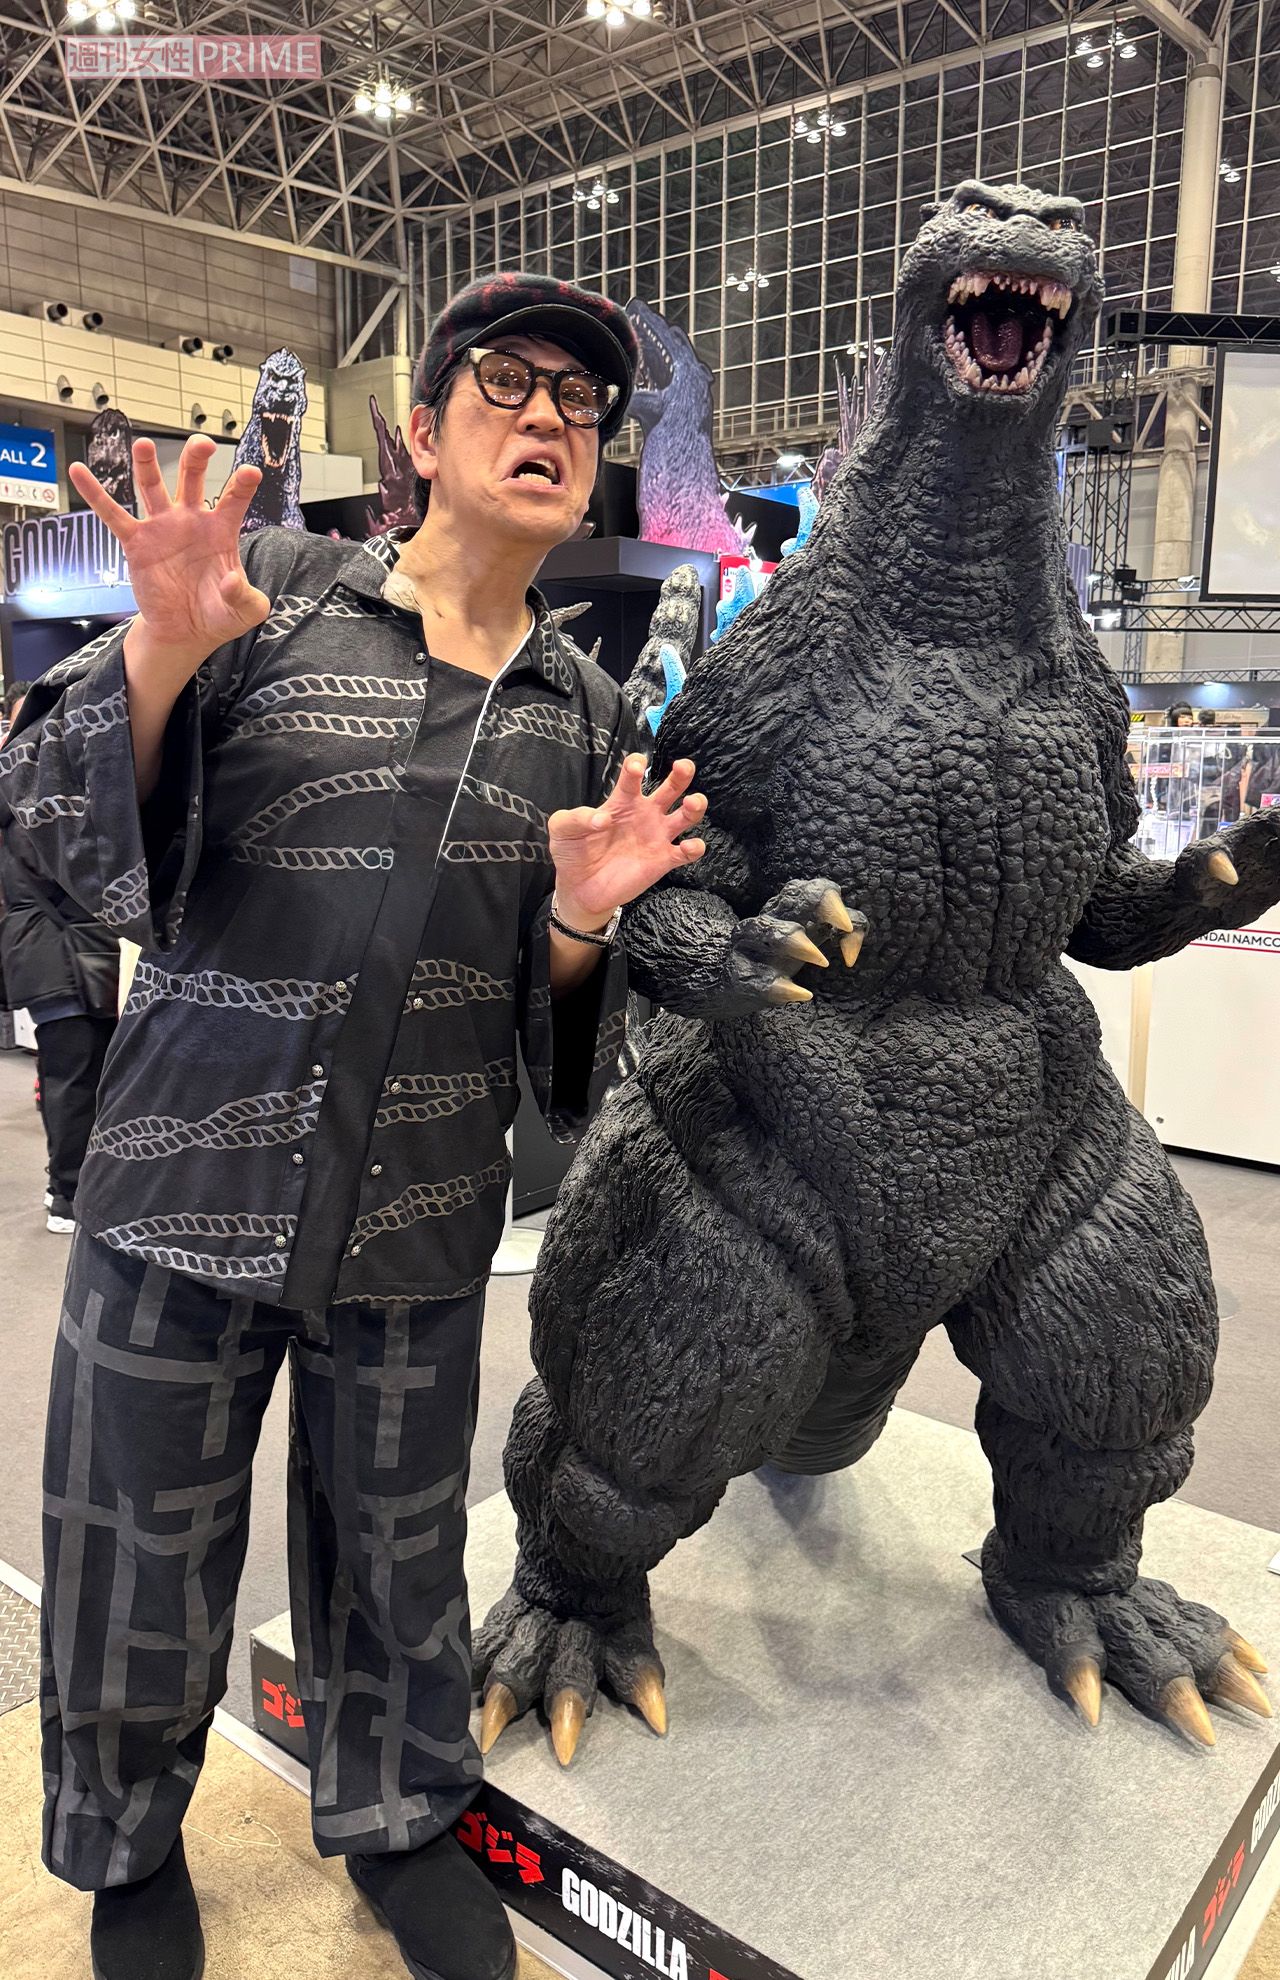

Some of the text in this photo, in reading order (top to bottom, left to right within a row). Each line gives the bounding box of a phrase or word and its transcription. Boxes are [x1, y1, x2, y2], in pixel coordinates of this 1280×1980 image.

[30, 442, 48, 468] 2
[1199, 932, 1280, 948] NDAI NAMCO
[456, 1810, 545, 1885] ゴジラ
[561, 1867, 689, 1980] GODZILLA
[1201, 1839, 1246, 1949] ゴジラ
